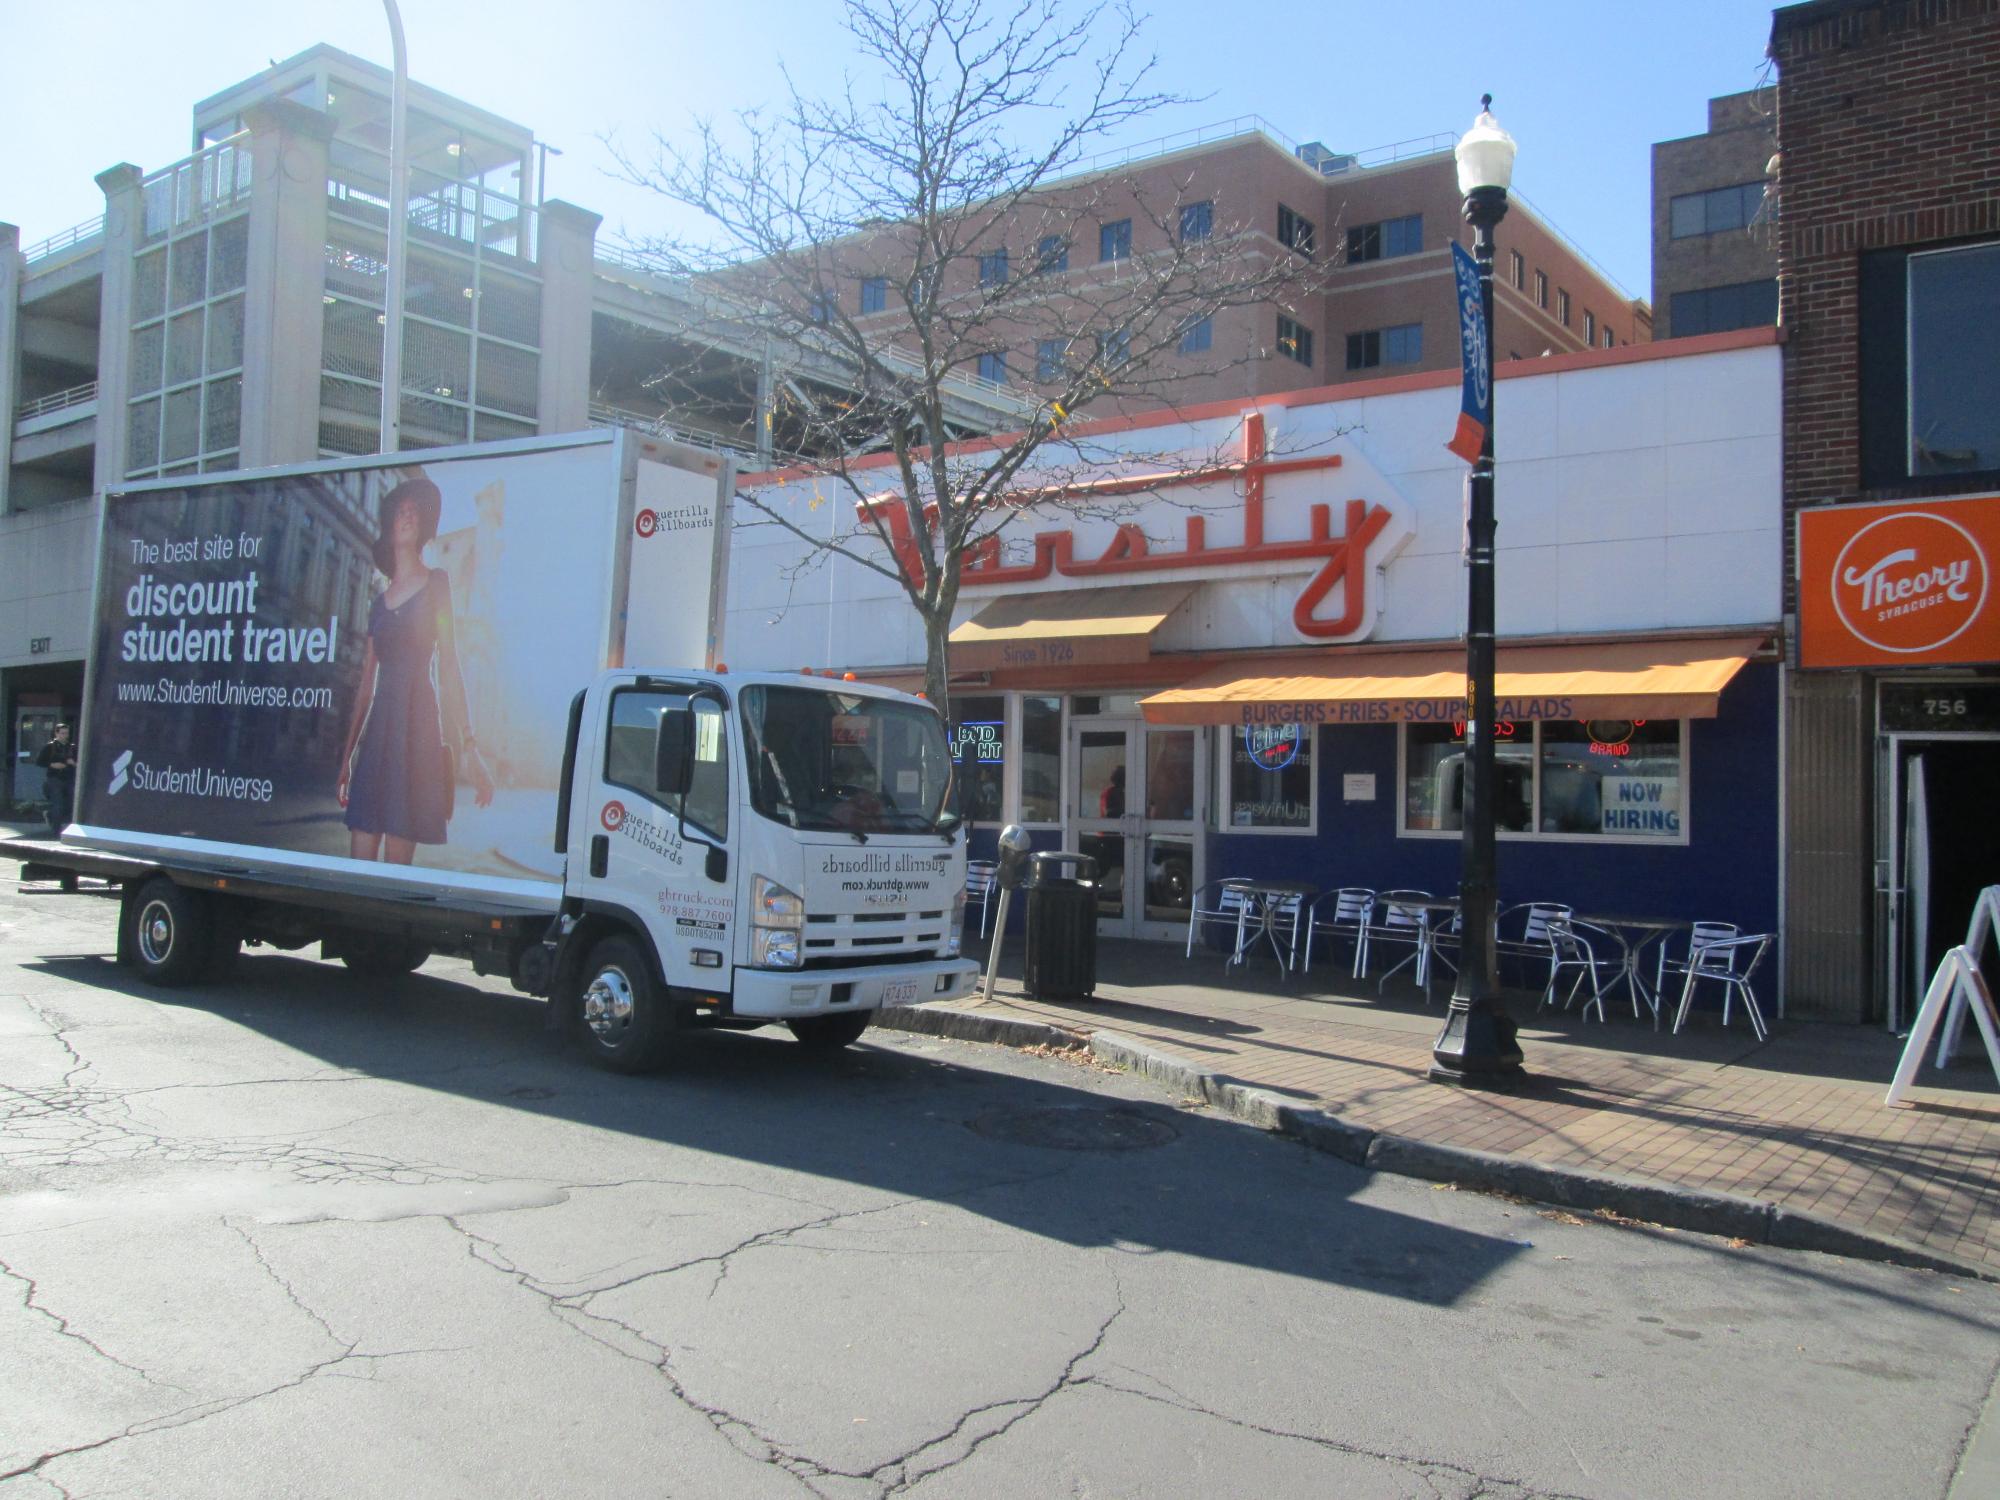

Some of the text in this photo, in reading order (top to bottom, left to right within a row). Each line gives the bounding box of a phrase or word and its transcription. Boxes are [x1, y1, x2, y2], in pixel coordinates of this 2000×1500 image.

[655, 505, 708, 523] guerrilla
[655, 517, 713, 532] billboards
[856, 412, 1392, 637] Varsity
[130, 532, 262, 564] The best site for
[1844, 548, 1970, 611] Theory
[126, 571, 258, 617] discount
[1877, 592, 1944, 622] SYRACUSE
[121, 615, 338, 663] student travel
[1003, 642, 1074, 663] Since 1926
[118, 678, 332, 708] www.StudentUniverse.com
[1242, 702, 1325, 722] BURGERS
[1340, 701, 1389, 721] FRIES
[1493, 698, 1572, 719] ALADS
[1923, 699, 1967, 715] 756
[958, 725, 995, 743] BUD
[950, 741, 1002, 758] LIHT
[1589, 743, 1630, 755] BRAND
[132, 761, 273, 802] StudentUniverse
[1618, 782, 1663, 802] NOW
[624, 811, 683, 850] guerrilla
[1604, 809, 1680, 830] HIRING
[617, 822, 684, 865] billboards
